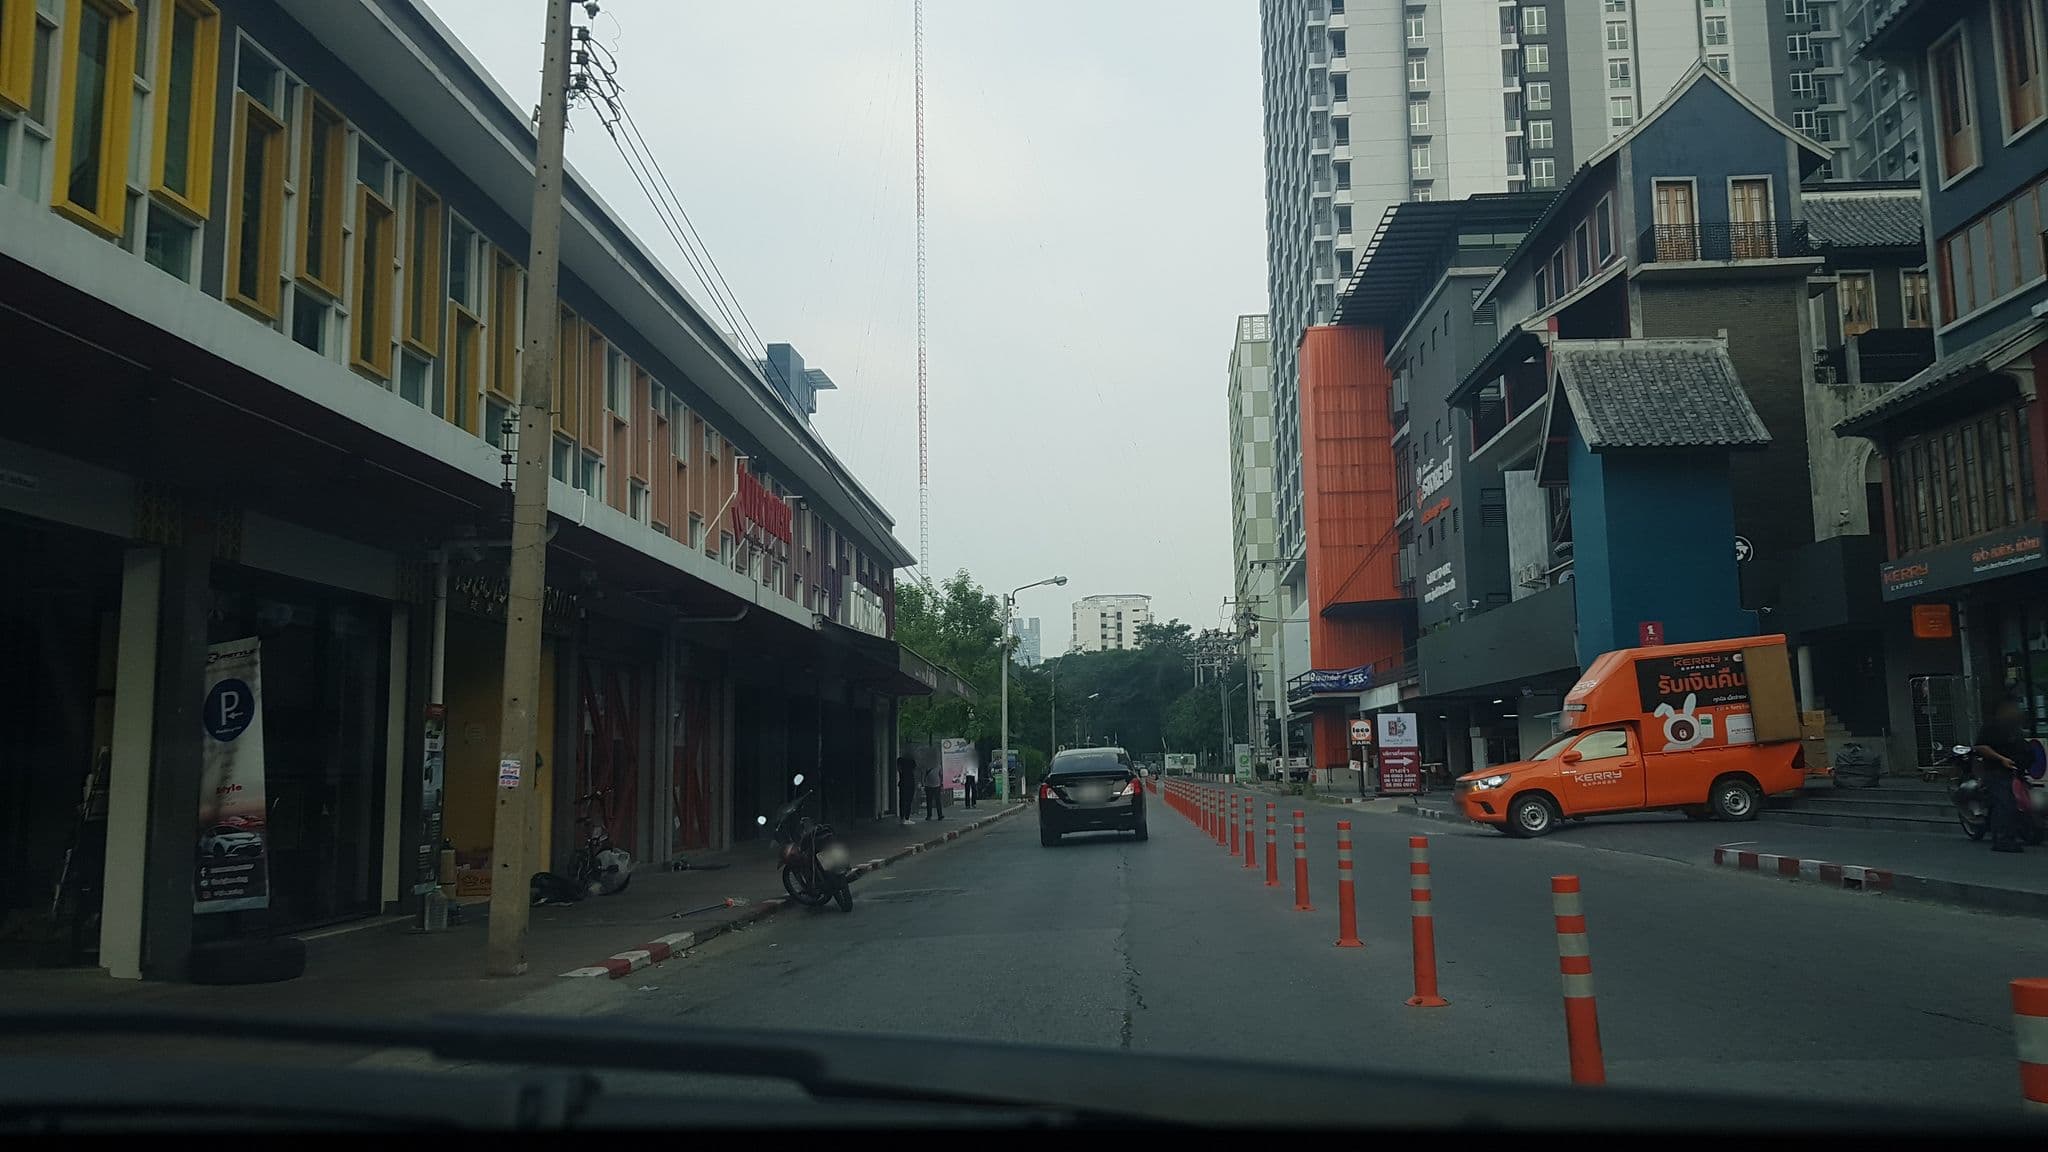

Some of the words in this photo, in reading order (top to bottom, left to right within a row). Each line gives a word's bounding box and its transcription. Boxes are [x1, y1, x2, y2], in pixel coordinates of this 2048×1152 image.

[1882, 562, 1929, 585] KERRY
[1890, 578, 1924, 592] EXPRESS
[1673, 655, 1721, 667] KERRY
[1574, 770, 1623, 783] KERRY
